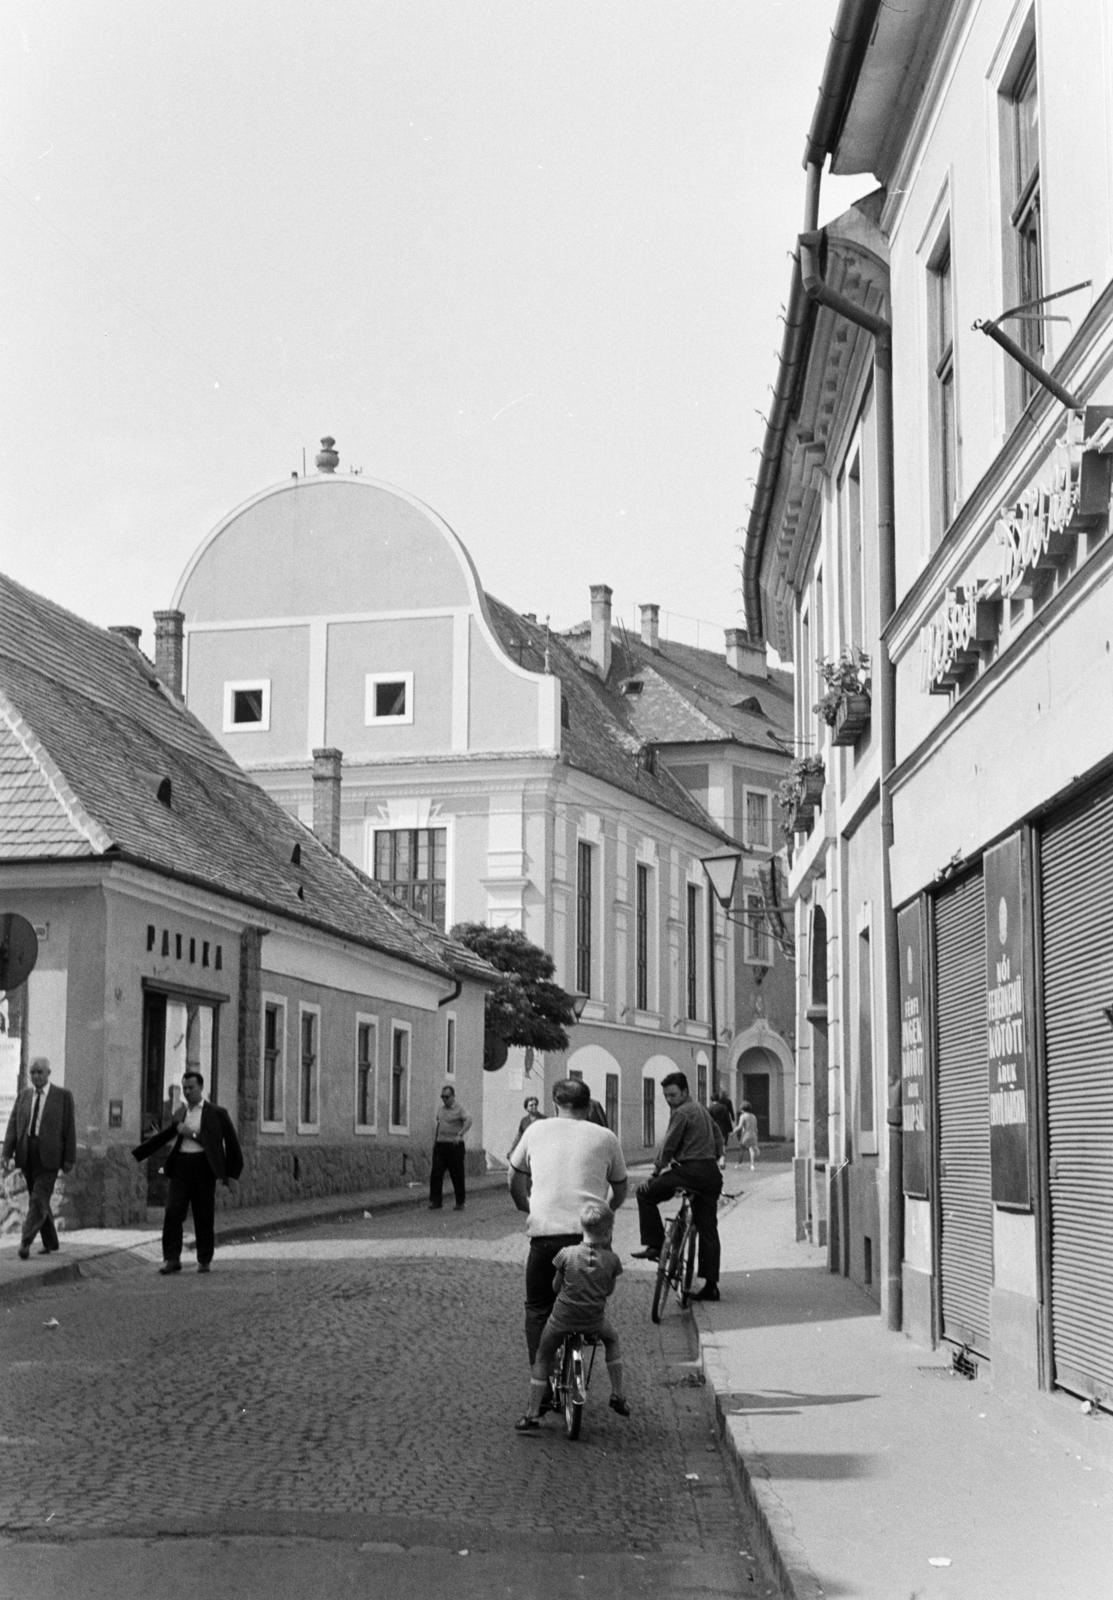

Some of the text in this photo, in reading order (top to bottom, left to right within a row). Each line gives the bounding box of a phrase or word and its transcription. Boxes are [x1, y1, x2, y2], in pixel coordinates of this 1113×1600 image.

[147, 925, 222, 970] PATIKA
[996, 954, 1010, 983] NŐI
[989, 1016, 1023, 1059] KÖTÖTT
[998, 1061, 1017, 1083] ÁRUK
